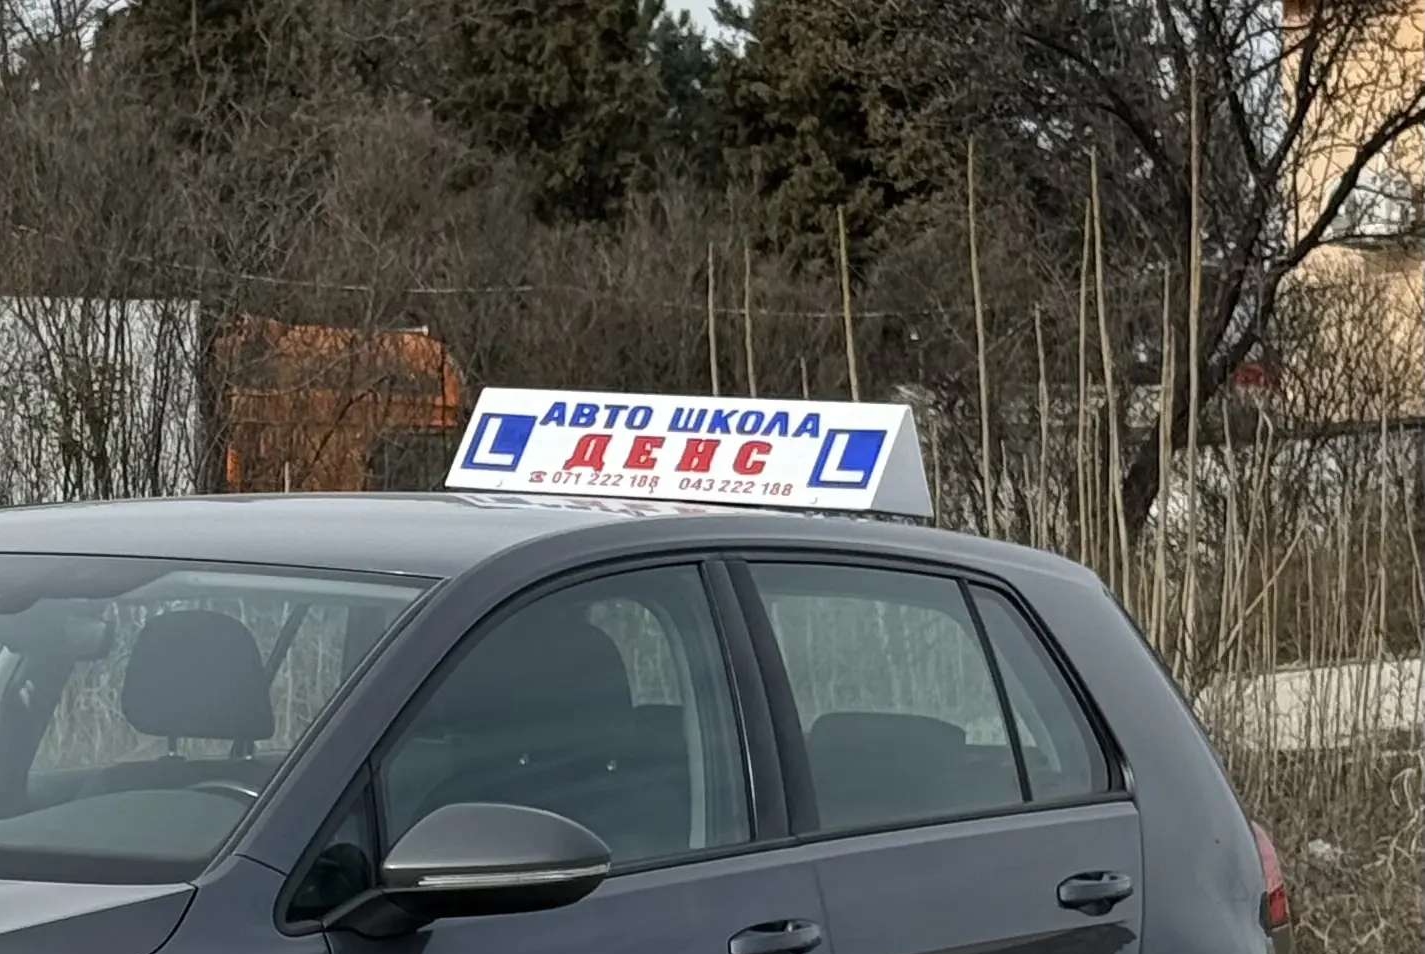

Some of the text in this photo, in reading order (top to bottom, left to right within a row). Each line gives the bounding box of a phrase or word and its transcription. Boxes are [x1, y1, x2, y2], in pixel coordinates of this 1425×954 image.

[539, 401, 821, 439] АВТО ШКОЛА
[562, 433, 774, 476] ДЕНС
[551, 471, 794, 497] 071 222 188 043 222 188
